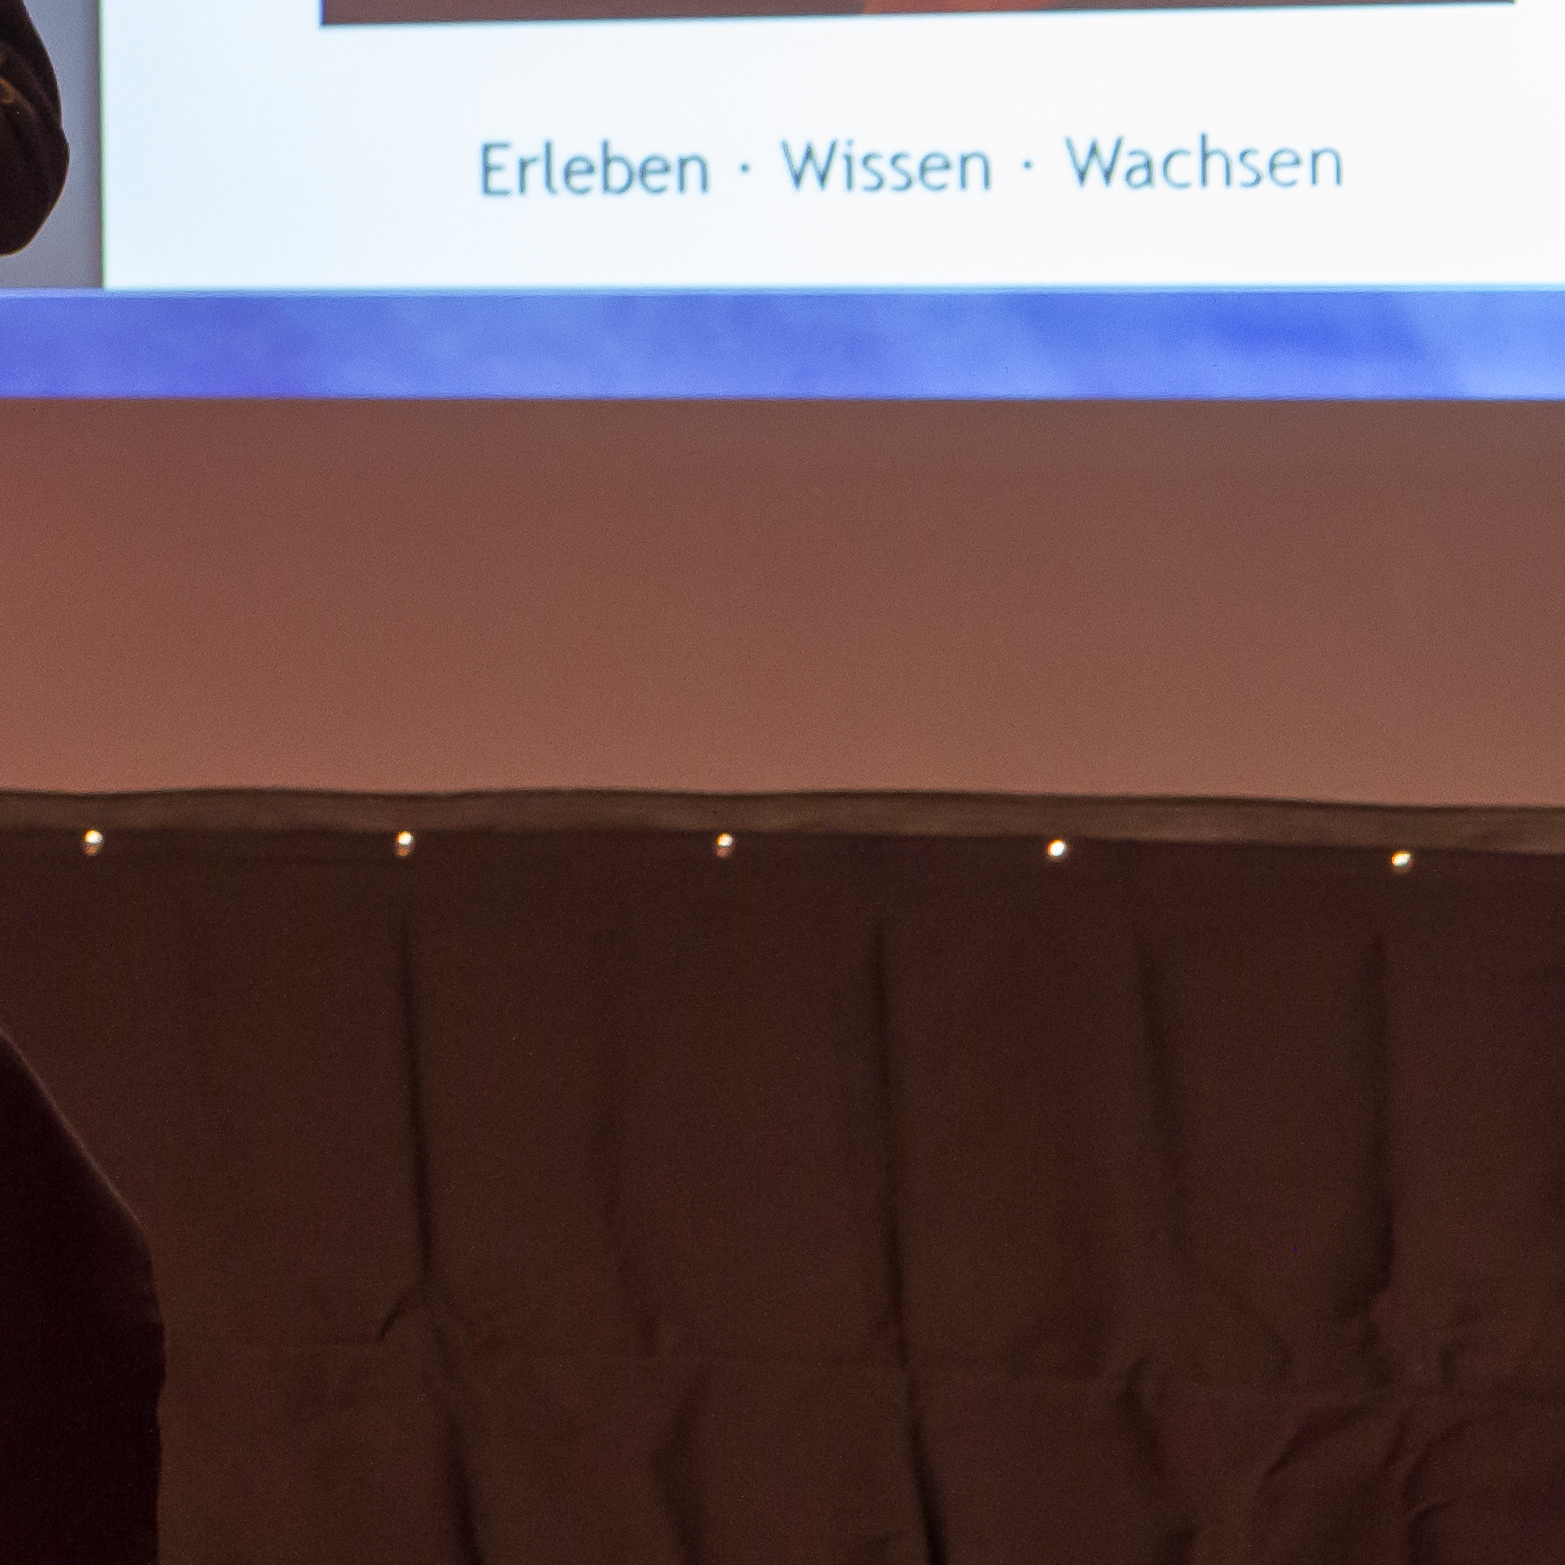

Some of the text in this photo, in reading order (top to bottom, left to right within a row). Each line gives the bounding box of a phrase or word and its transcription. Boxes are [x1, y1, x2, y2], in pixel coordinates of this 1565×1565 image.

[480, 132, 1345, 198] Erleben Wissen Wachsen
